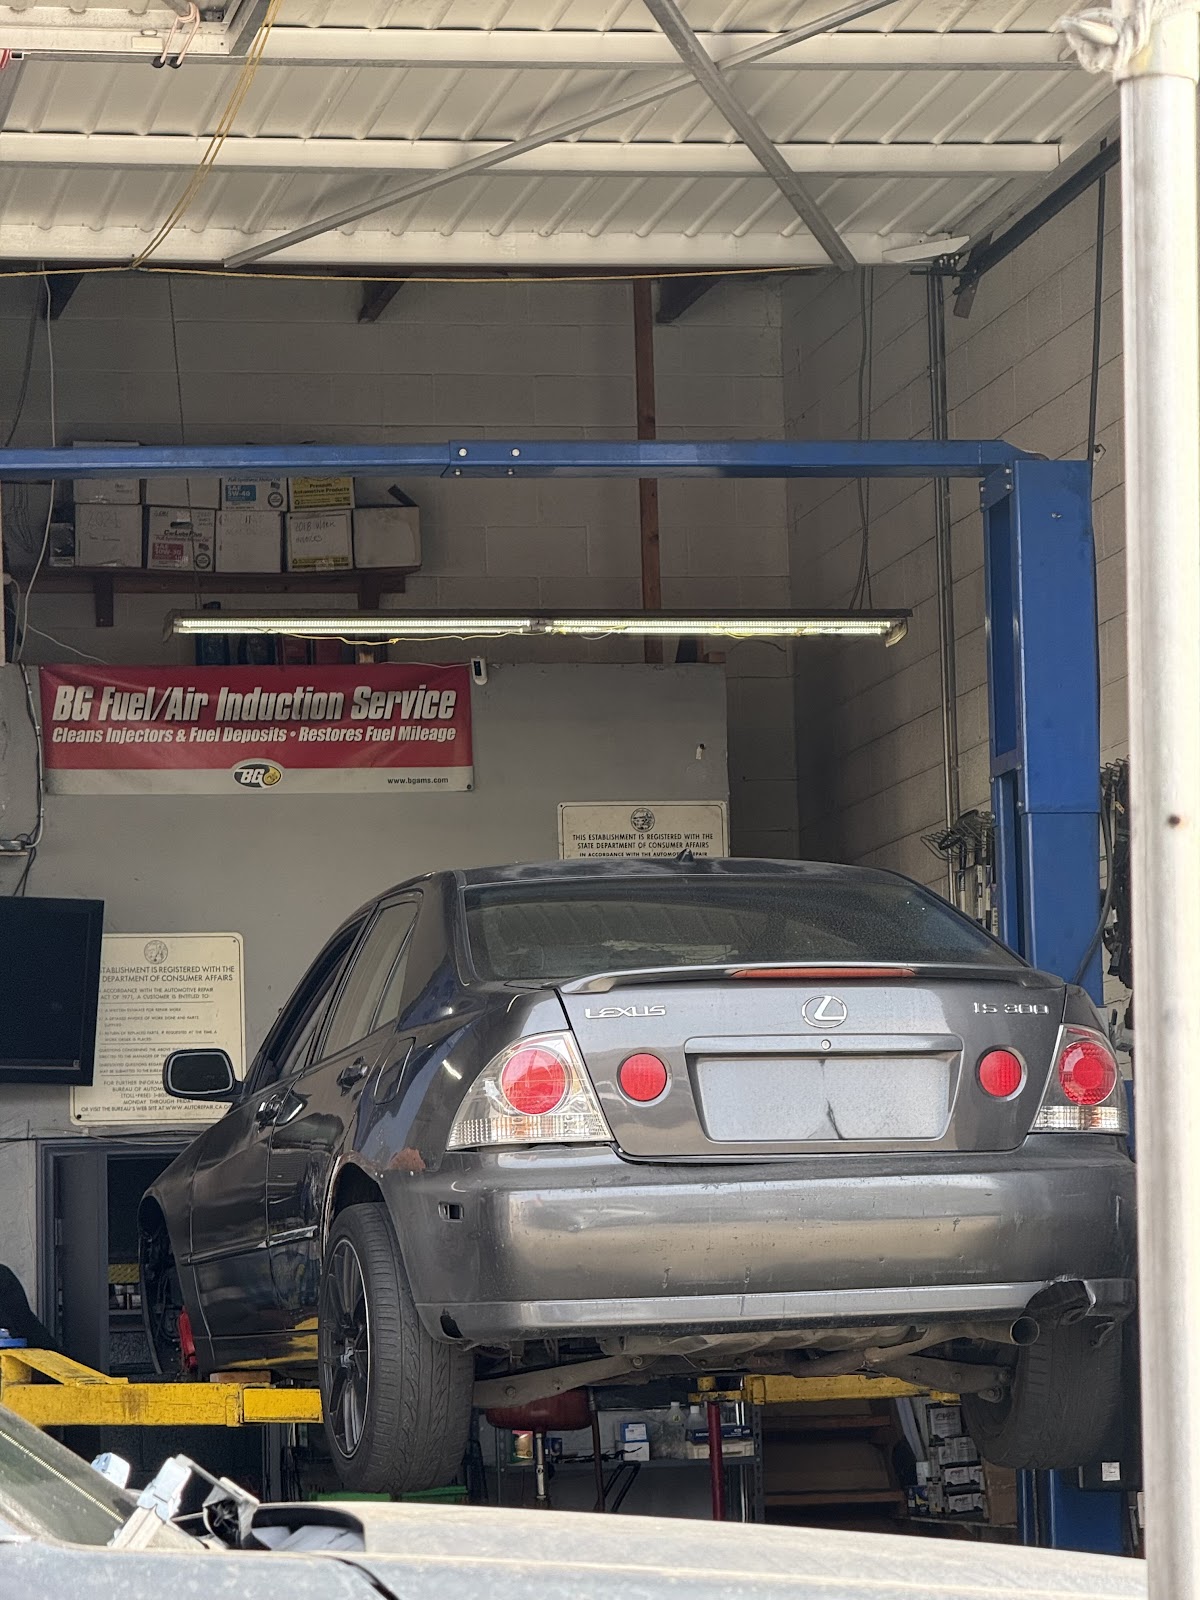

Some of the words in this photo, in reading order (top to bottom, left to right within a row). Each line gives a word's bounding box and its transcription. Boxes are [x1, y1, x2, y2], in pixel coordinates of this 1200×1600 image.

[53, 685, 94, 721] BG
[98, 686, 209, 721] Fuel/Air
[215, 686, 345, 721] Induction
[351, 684, 457, 720] Service
[52, 727, 103, 743] Cleans
[106, 727, 173, 744] Injectors
[176, 728, 187, 741] &
[189, 727, 220, 742] Fuel
[223, 727, 287, 743] Deposits
[299, 727, 363, 742] Restores
[365, 726, 396, 741] Fuel
[398, 726, 457, 743] Mileage
[235, 768, 264, 784] BG
[387, 776, 449, 785] www.bgams.com
[588, 833, 636, 841] ESTABLISHMENT
[646, 833, 682, 841] REGISTERED
[648, 841, 683, 849] CONSUMER
[685, 841, 710, 849] AFFAIRS
[101, 966, 150, 974] TABLISHMENT
[159, 965, 201, 973] REGISTERED
[202, 965, 221, 973] WITH
[102, 975, 149, 983] DEPARTMENT
[161, 974, 203, 982] CONSUMER
[205, 973, 233, 981] AFFAIRS
[585, 1005, 666, 1019] LEXUS
[973, 1002, 998, 1014] IS
[1004, 1003, 1049, 1015] 300
